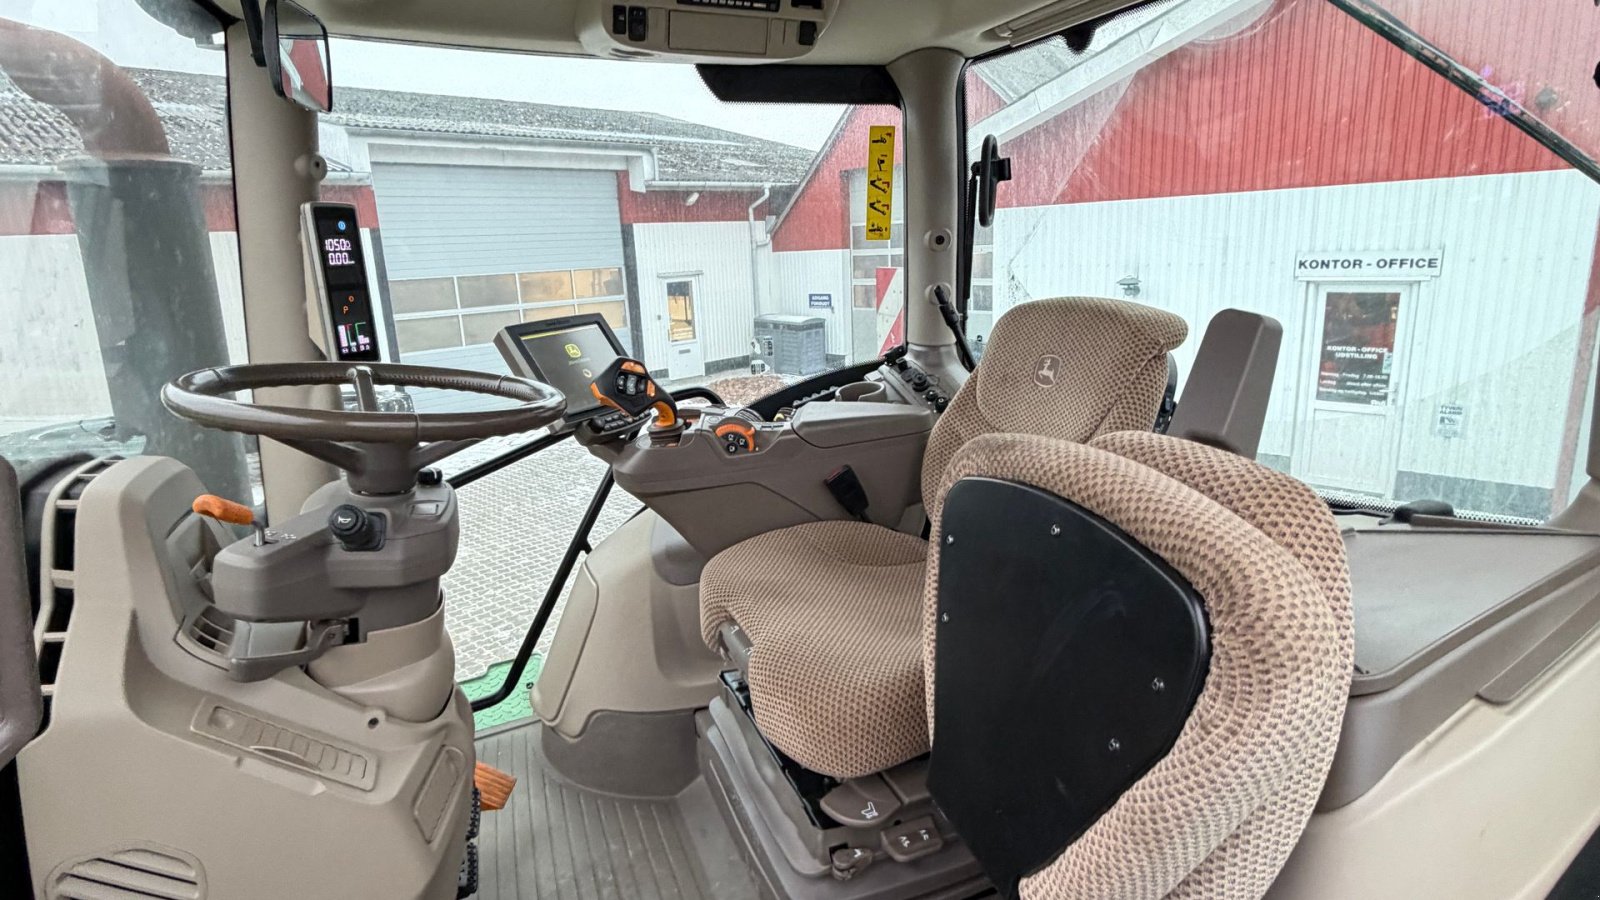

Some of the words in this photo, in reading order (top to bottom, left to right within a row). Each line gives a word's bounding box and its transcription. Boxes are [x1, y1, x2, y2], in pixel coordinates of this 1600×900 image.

[325, 239, 346, 251] 1050
[1298, 259, 1363, 270] KONTOR
[1376, 258, 1439, 269] OFFICE
